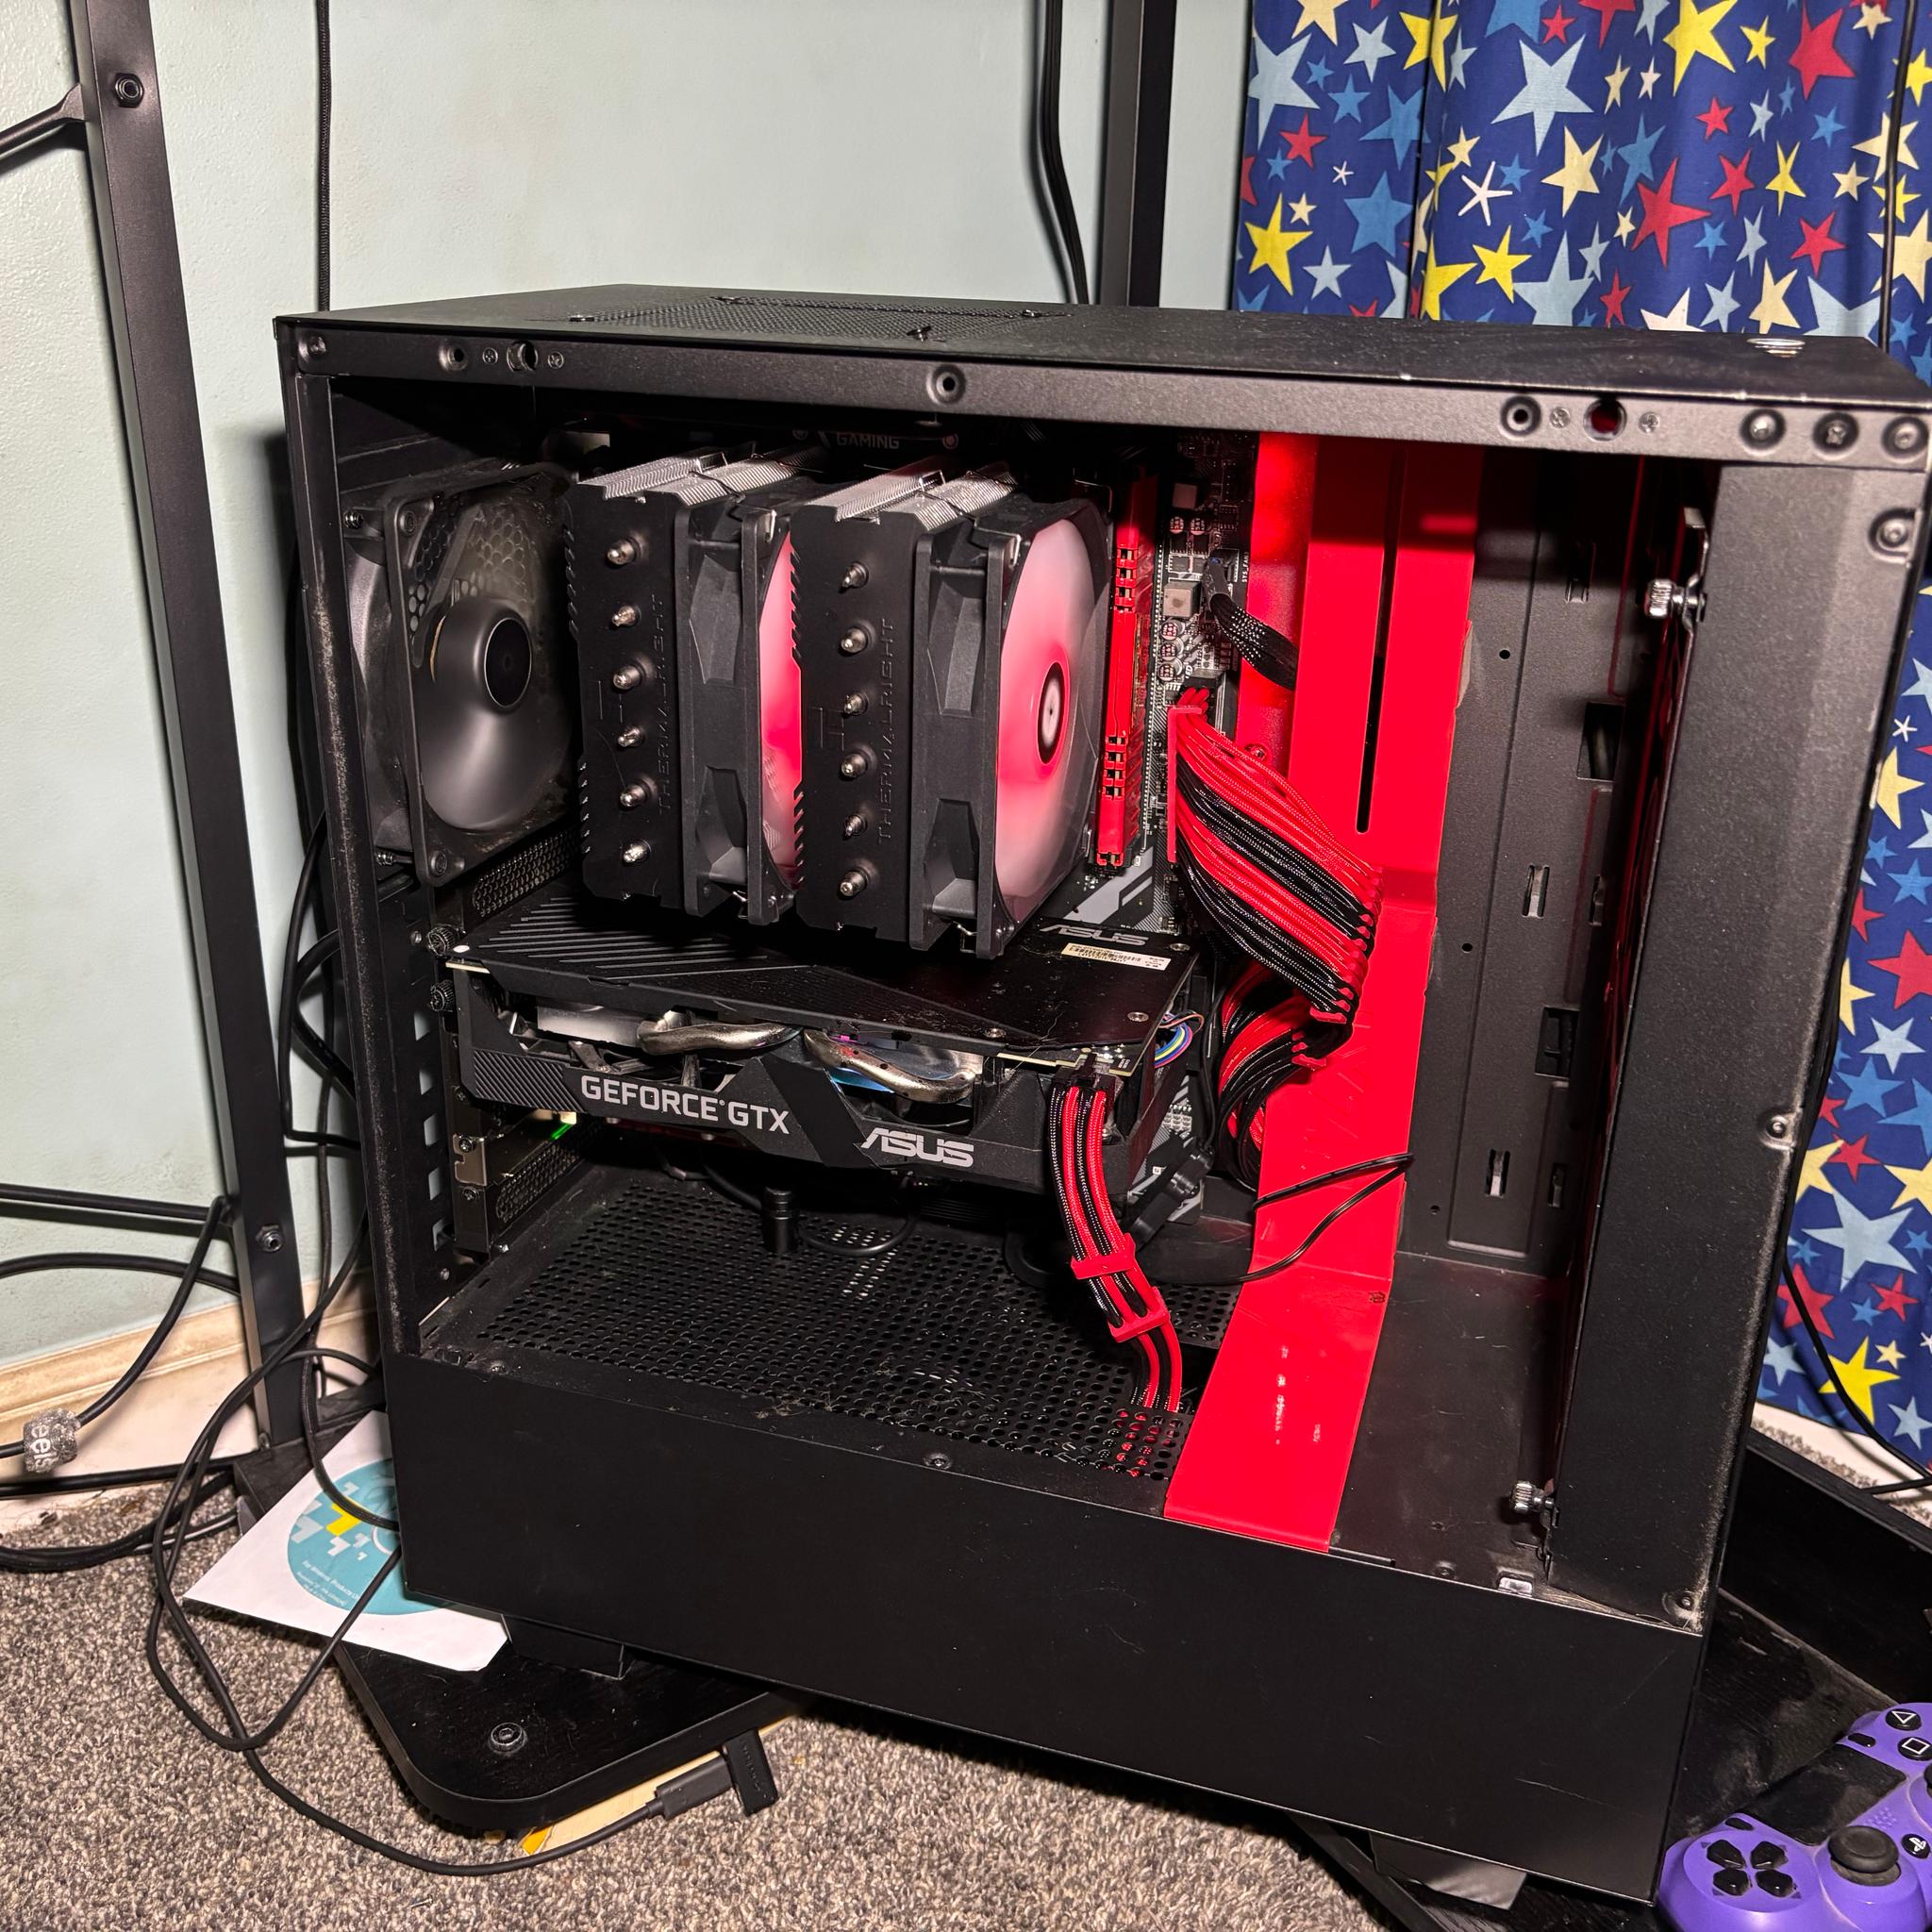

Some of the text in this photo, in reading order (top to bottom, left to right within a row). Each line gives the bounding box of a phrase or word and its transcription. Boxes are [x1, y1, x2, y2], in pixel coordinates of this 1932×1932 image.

[837, 432, 900, 449] GAMING
[877, 618, 893, 842] THERMALRIGHT
[1040, 924, 1149, 946] ASUS
[728, 1102, 791, 1134] GTX
[860, 1127, 974, 1168] ASUS
